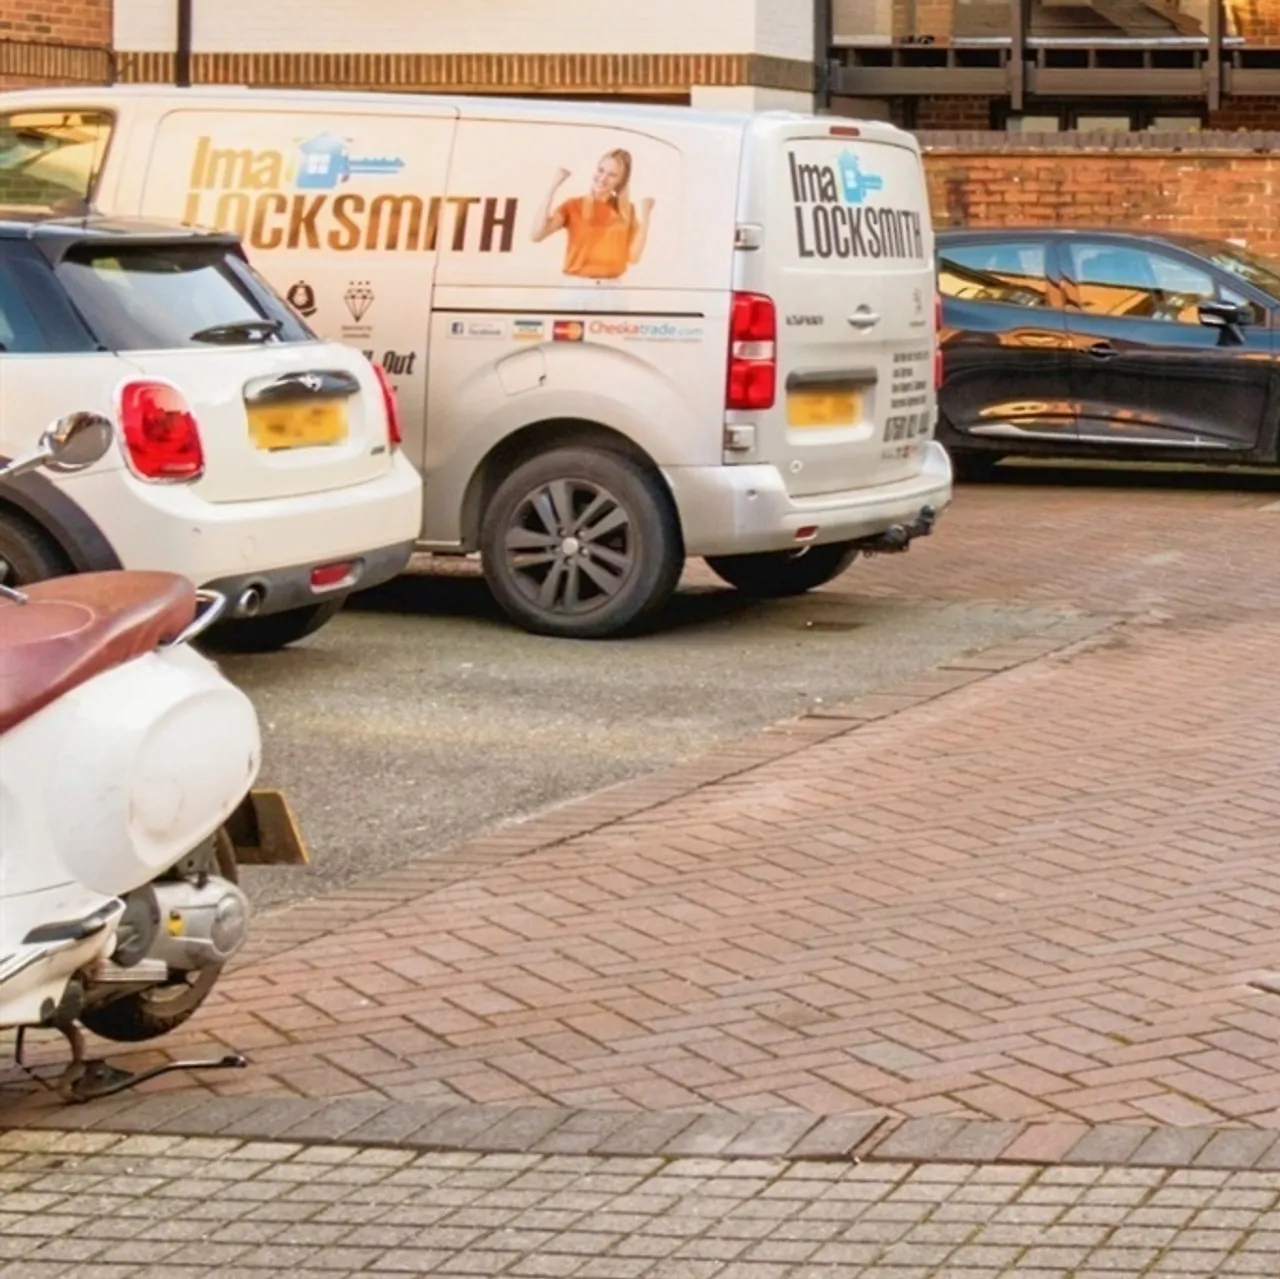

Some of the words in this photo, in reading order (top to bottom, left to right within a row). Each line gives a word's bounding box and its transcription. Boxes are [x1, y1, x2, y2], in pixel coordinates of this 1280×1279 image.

[190, 136, 283, 189] Ima
[788, 151, 838, 203] Ima
[184, 193, 518, 252] LOCKSMITH
[795, 205, 923, 259] LOCKSMITH
[382, 350, 417, 375] Out
